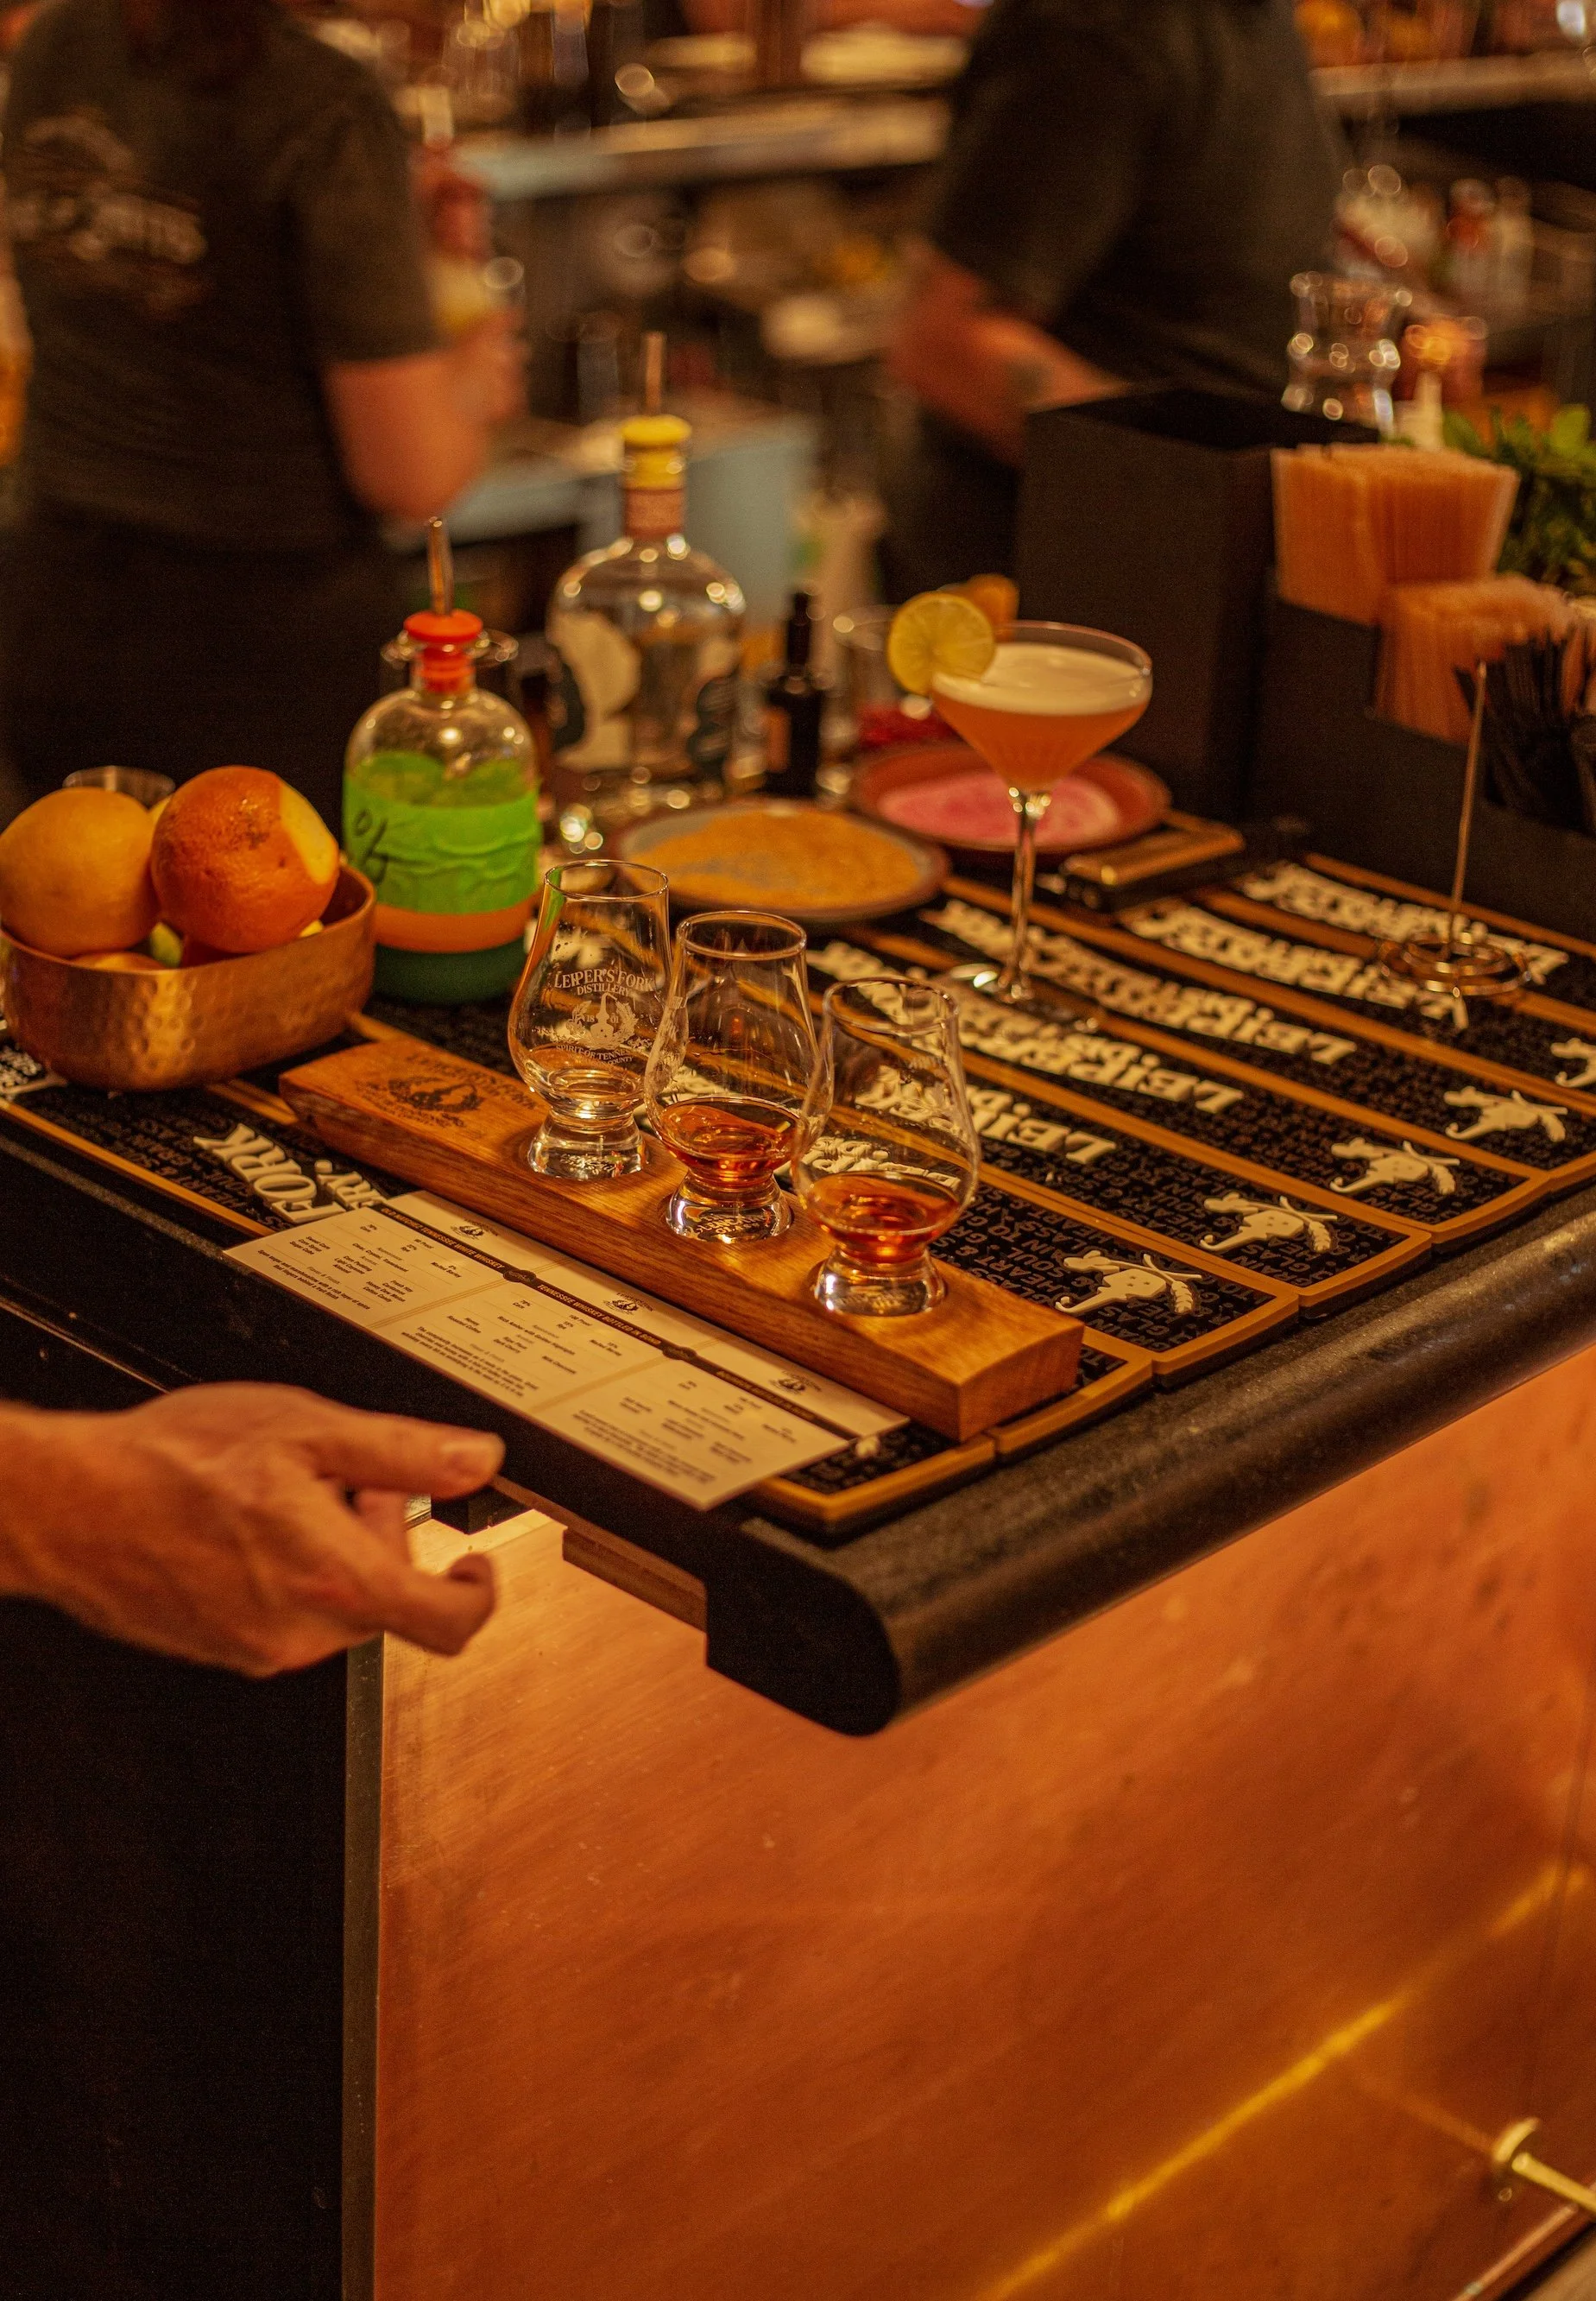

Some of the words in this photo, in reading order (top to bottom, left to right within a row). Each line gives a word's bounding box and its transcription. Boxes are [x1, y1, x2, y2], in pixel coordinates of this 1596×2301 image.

[554, 968, 615, 989] LEIPER'S
[617, 969, 656, 992] FORK
[577, 983, 631, 996] DISTILLERY
[555, 1045, 584, 1053] SPIRIT
[193, 1123, 345, 1225] FORK
[421, 1227, 456, 1245] TENNESSEE
[454, 1243, 476, 1255] WHITE
[474, 1253, 504, 1267] WHISKEY
[998, 1247, 1074, 1279] SOUL
[1237, 1242, 1314, 1274] GLAS
[289, 1267, 319, 1282] marshmallow
[972, 1253, 1065, 1293] HEART
[537, 1284, 575, 1303] TENNESSEE
[572, 1301, 603, 1317] WHISKEY
[602, 1316, 633, 1331] BOTTLED
[1094, 1304, 1173, 1337] GLAS
